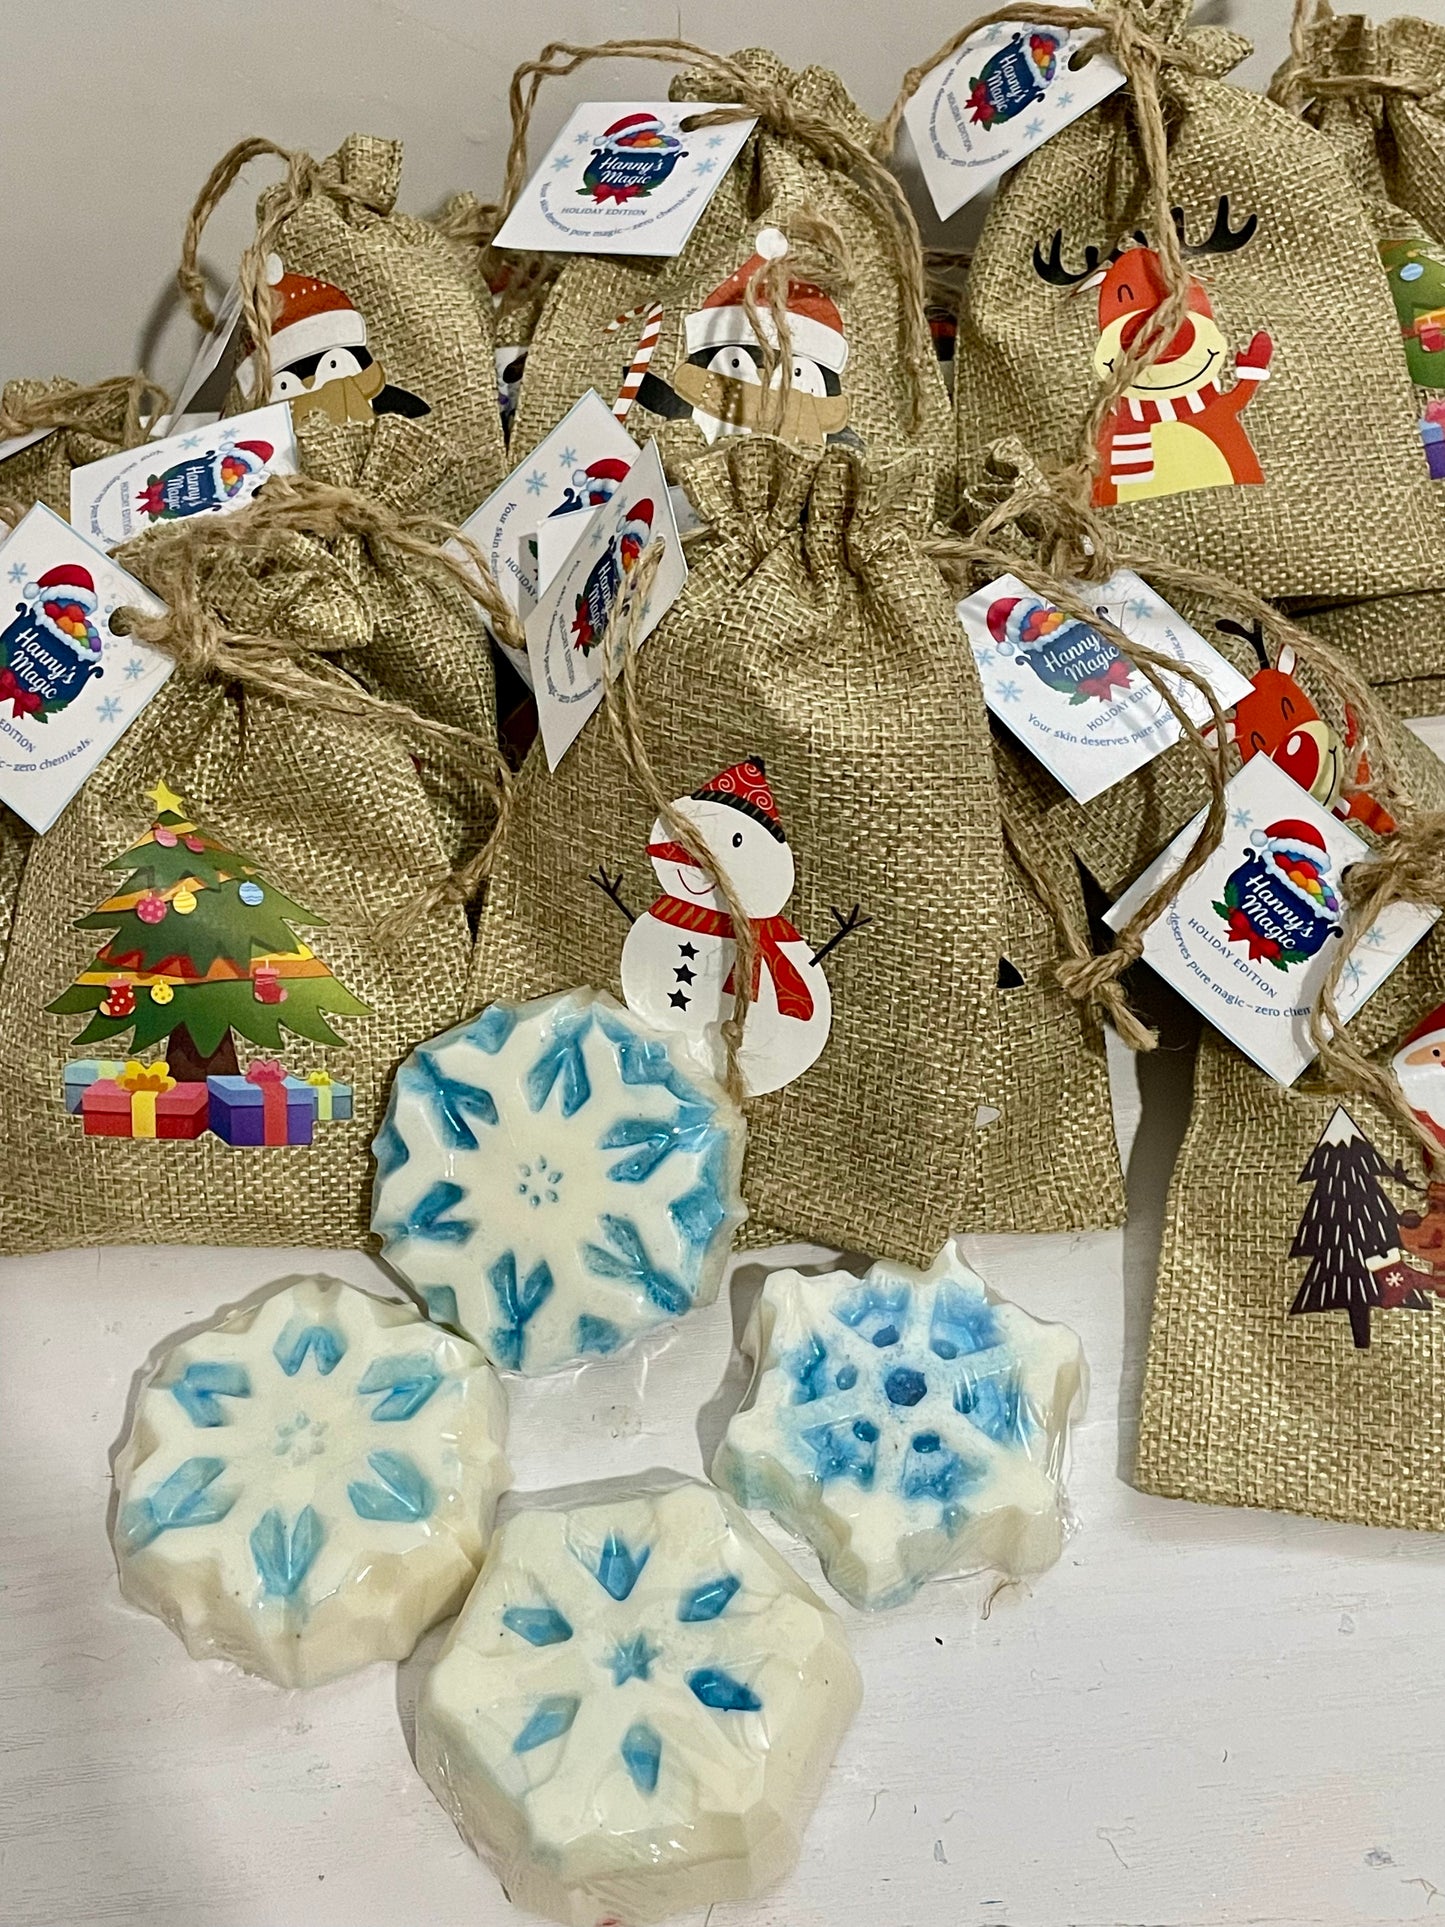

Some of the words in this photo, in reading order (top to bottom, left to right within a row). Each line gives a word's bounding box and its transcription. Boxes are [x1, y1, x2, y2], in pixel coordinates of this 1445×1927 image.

[987, 70, 1010, 113] Magic
[1000, 53, 1029, 103] Hanny's
[598, 156, 664, 175] Hanny's
[600, 170, 652, 188] Magic
[560, 207, 604, 215] HOLIDAY
[605, 208, 648, 216] EDITION
[162, 475, 185, 511] Magic
[182, 465, 208, 508] Hanny's
[500, 502, 518, 525] Your
[491, 526, 504, 549] skin
[505, 557, 538, 598] HOLIDAY
[15, 627, 77, 685] Hanny's
[1064, 646, 1119, 682] Magic
[10, 650, 57, 699] Magic
[1027, 712, 1052, 733] Your
[1053, 728, 1078, 743] skin
[1080, 735, 1130, 747] deserves
[1131, 725, 1156, 743] pure
[1086, 701, 1130, 732] HOLIDAY
[0, 718, 36, 753] EDITION
[13, 763, 37, 771] zero
[1241, 894, 1296, 949] Magic
[1245, 874, 1315, 938] Hanny's
[1170, 912, 1192, 960] deserves
[1186, 959, 1212, 985] pure
[1211, 983, 1245, 1008] magic
[1255, 1005, 1280, 1016] zero
[1187, 917, 1234, 959] HOLIDAY
[1233, 958, 1278, 999] EDITION
